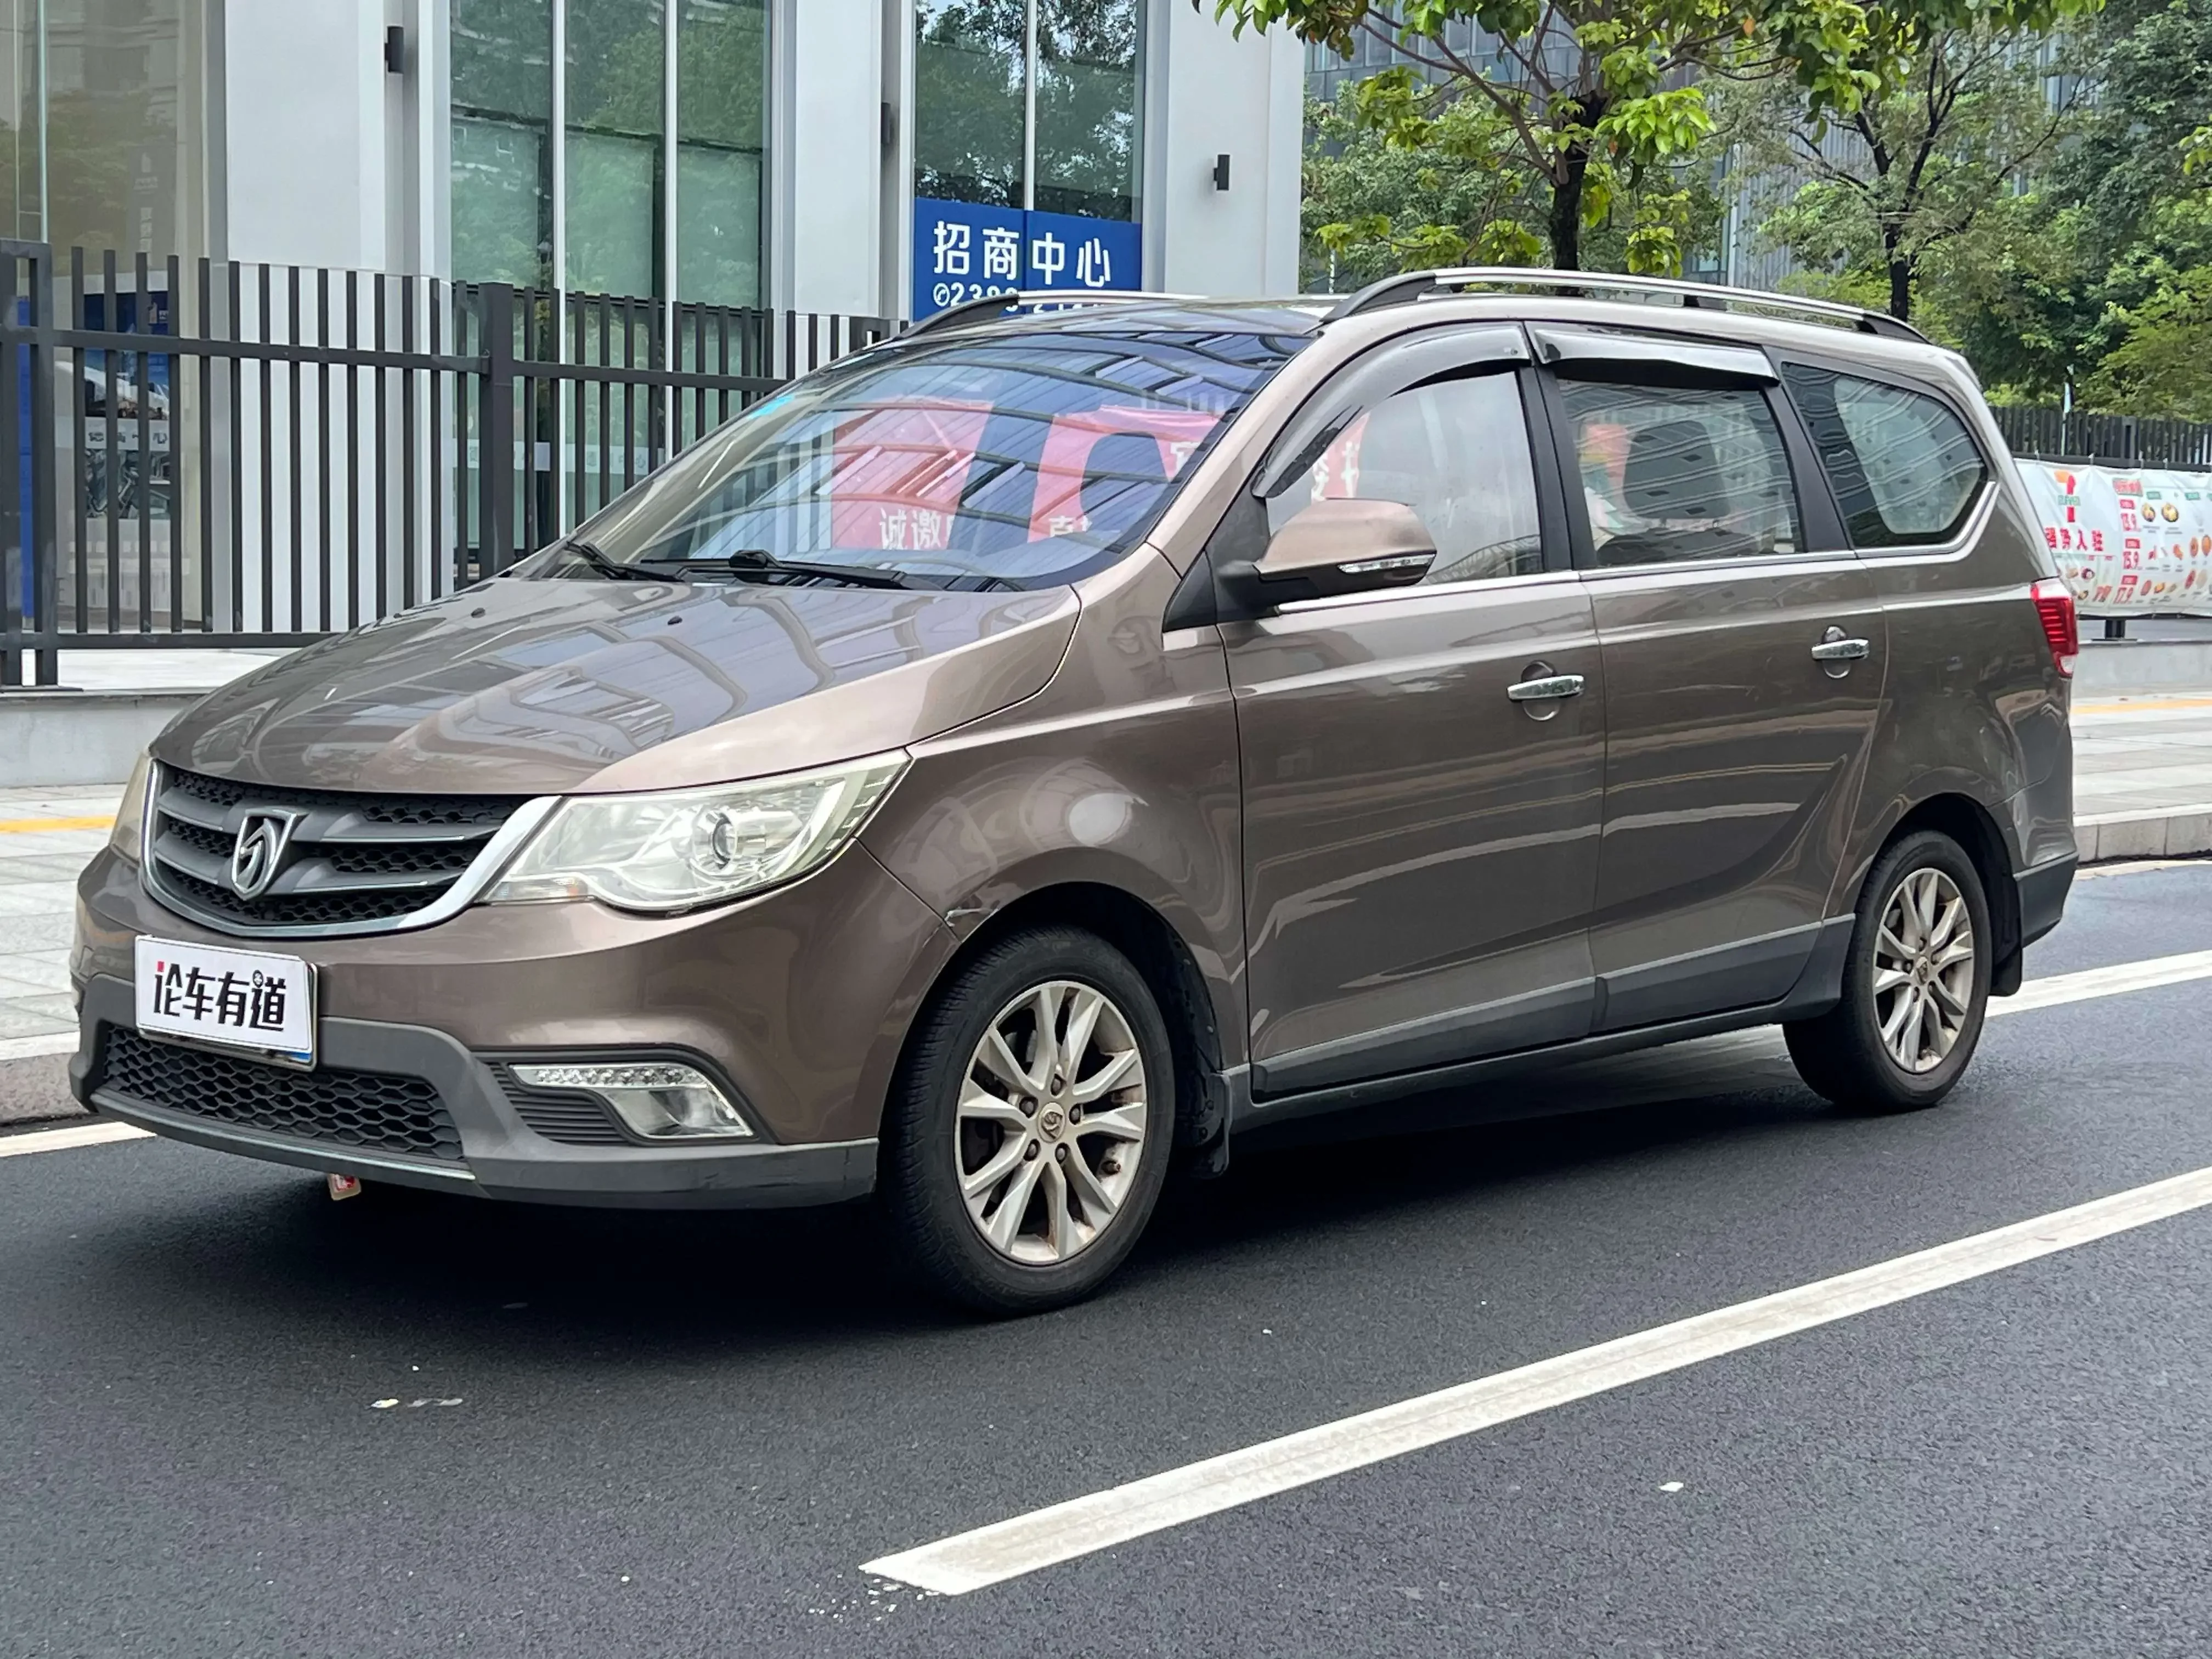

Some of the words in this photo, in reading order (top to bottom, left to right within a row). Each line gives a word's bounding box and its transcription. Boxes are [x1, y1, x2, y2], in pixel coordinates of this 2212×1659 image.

[934, 220, 1111, 287] 招商中心
[153, 961, 286, 1031] 论车有道
